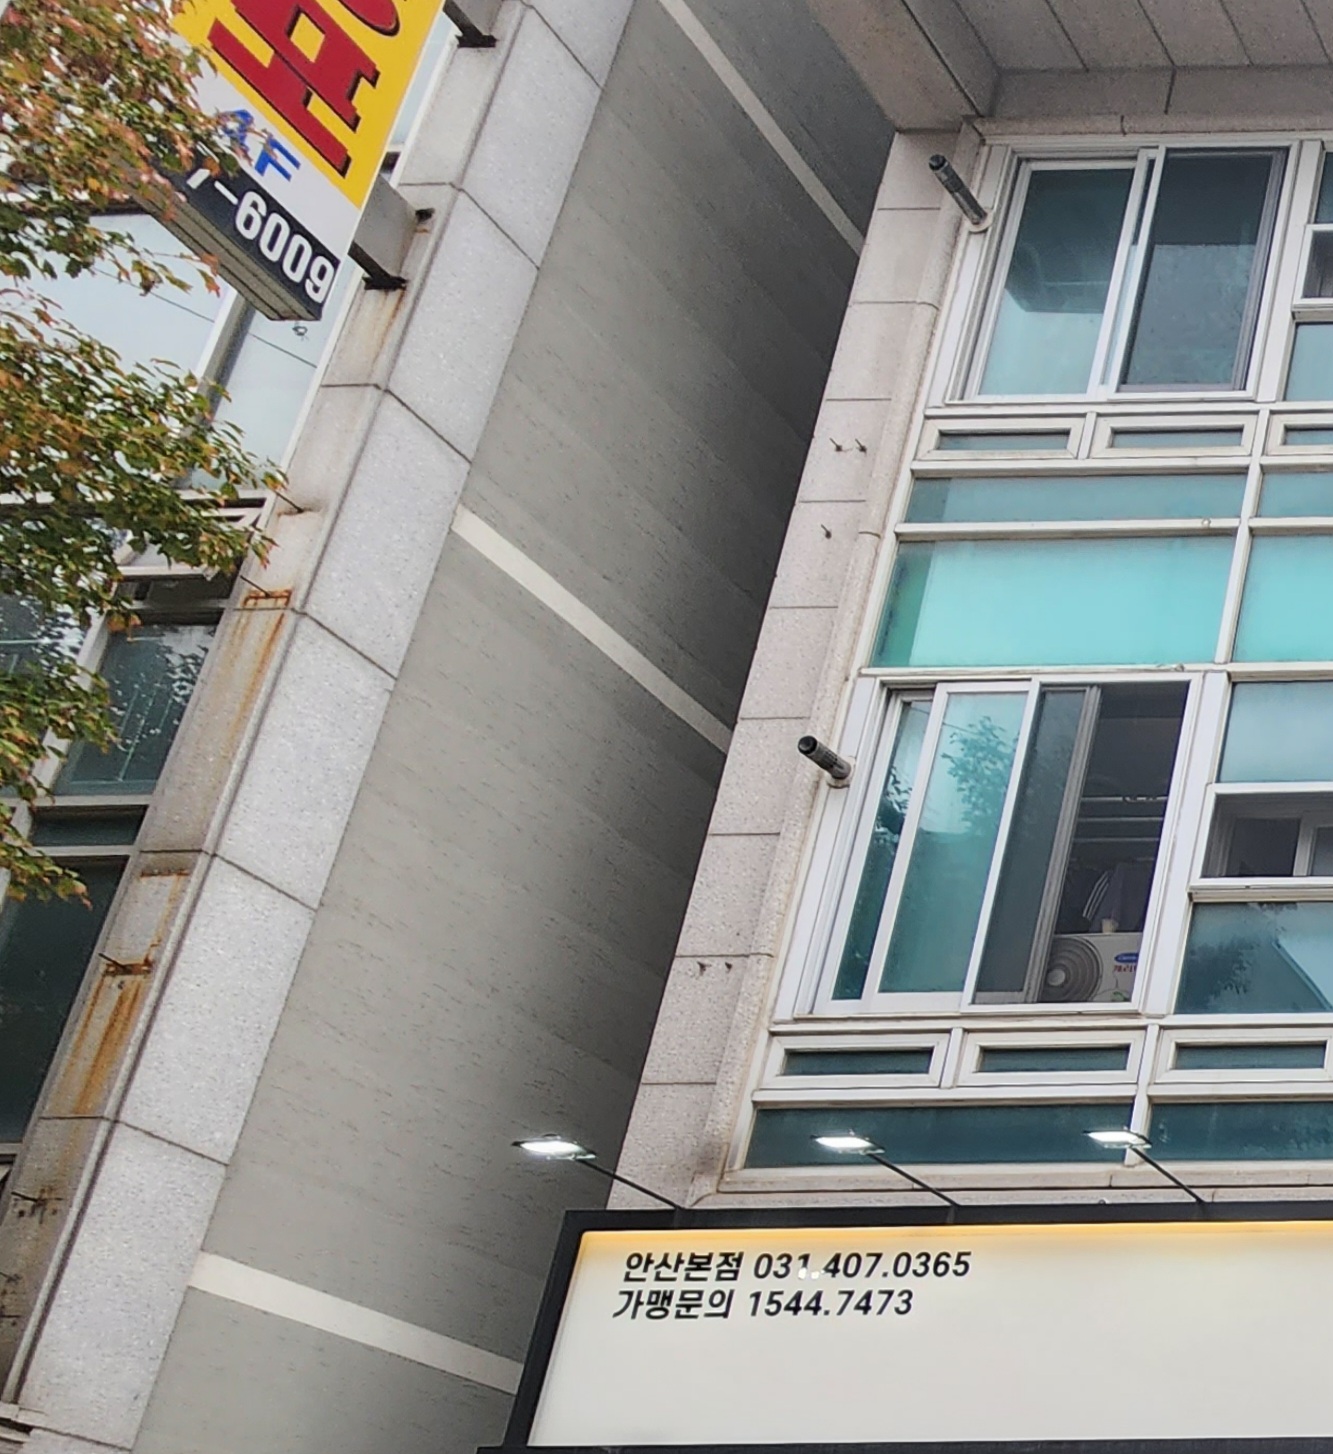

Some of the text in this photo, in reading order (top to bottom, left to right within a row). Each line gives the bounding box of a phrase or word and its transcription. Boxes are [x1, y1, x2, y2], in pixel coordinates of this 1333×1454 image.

[624, 1250, 972, 1283] 안산본점 031.407.0365
[612, 1289, 914, 1320] 가맹문의 1544.7473
